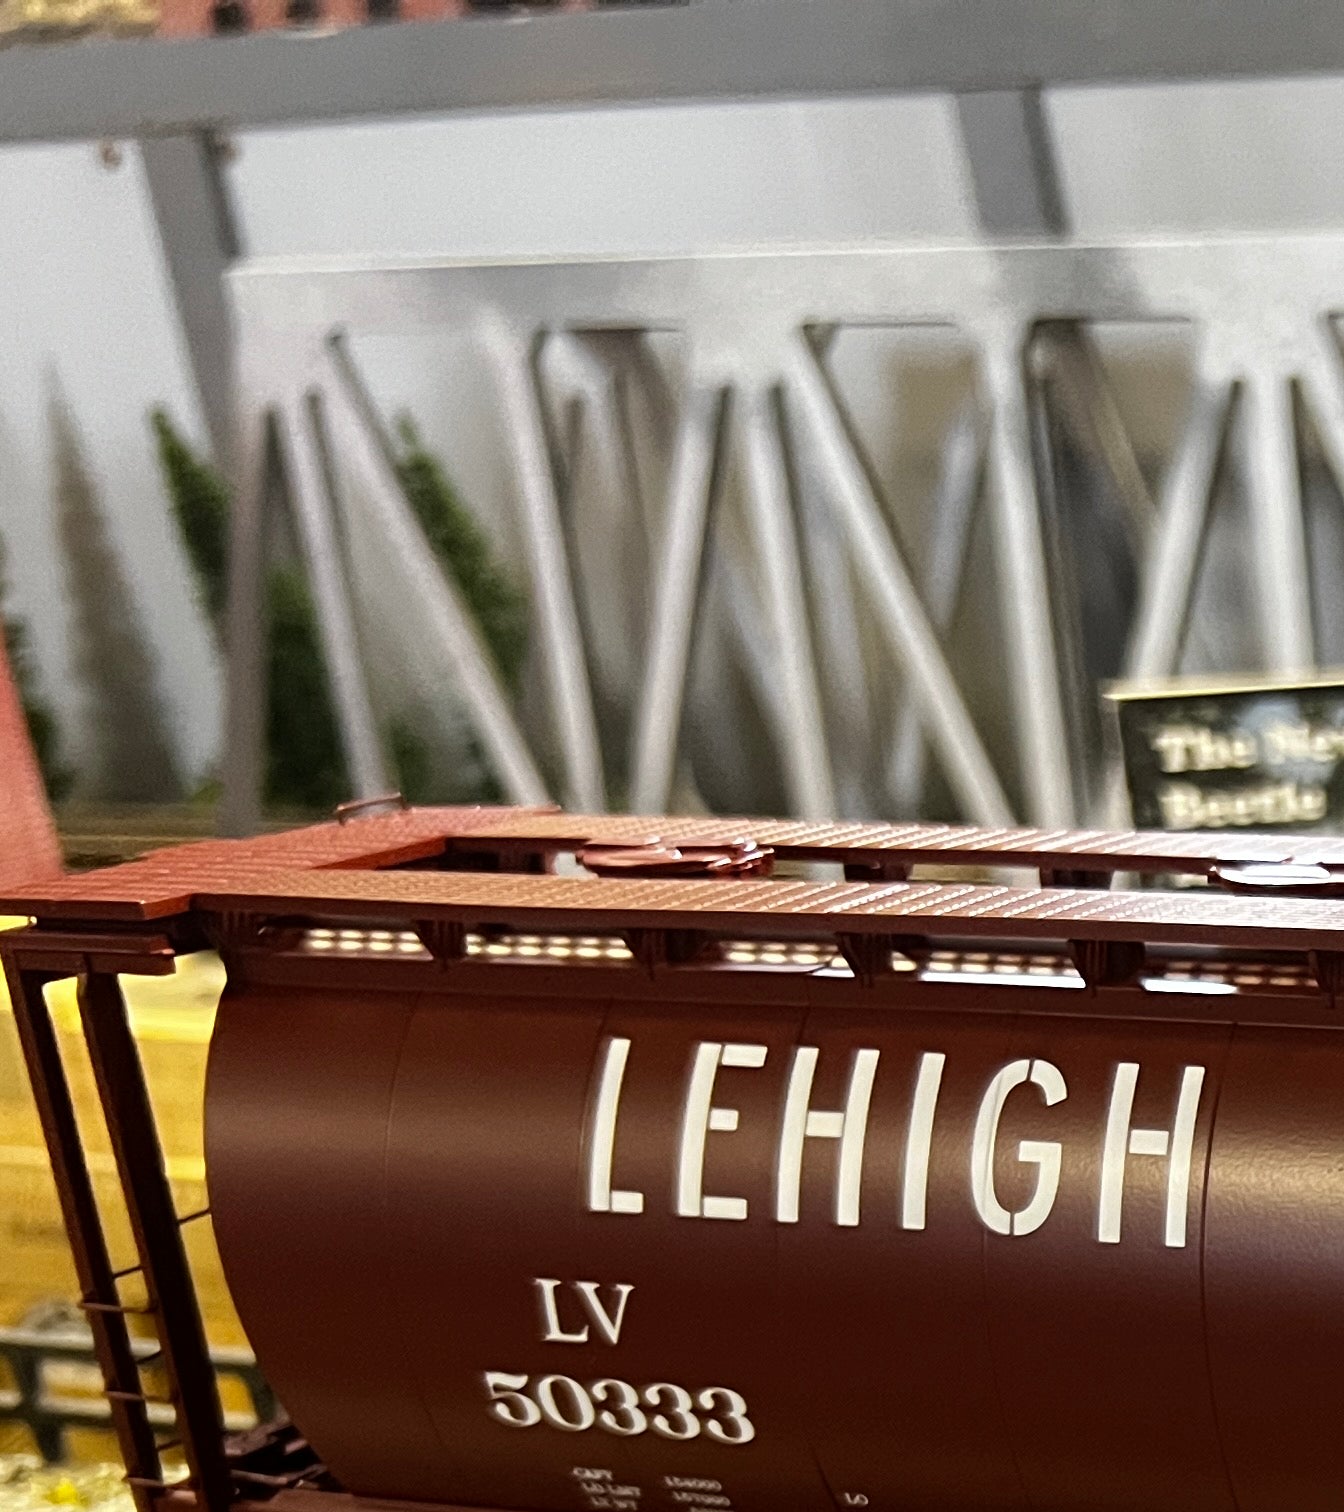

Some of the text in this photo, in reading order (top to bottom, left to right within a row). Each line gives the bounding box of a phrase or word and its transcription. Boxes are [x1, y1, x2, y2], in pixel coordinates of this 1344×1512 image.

[1154, 725, 1257, 772] The
[1158, 782, 1328, 829] Beetle
[589, 1038, 1205, 1248] LEHIGH
[533, 1277, 635, 1345] LV
[484, 1370, 755, 1446] 50333
